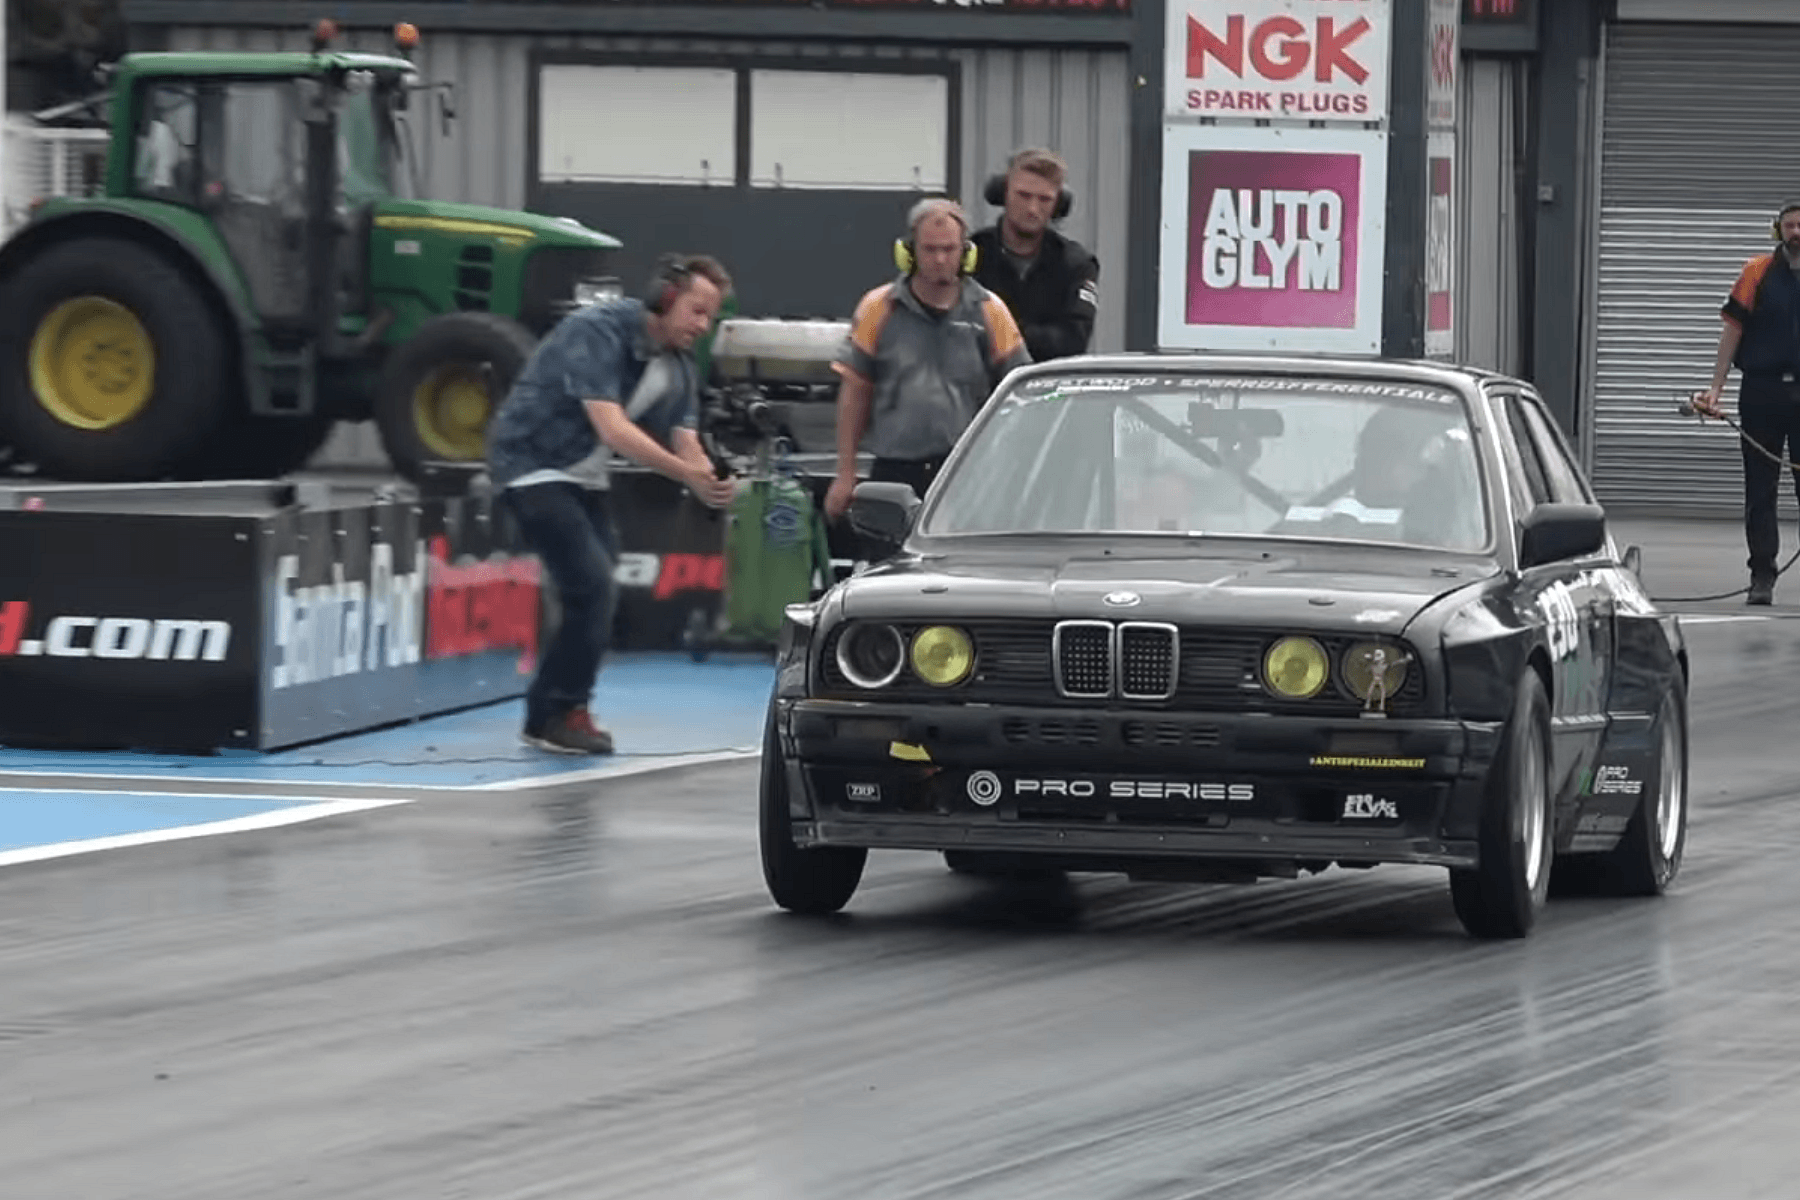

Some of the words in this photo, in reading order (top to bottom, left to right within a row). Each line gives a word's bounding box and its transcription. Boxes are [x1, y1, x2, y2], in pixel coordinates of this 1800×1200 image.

[1186, 13, 1371, 85] NGK
[1187, 89, 1271, 110] SPARK
[1280, 92, 1368, 113] PLUGS
[1203, 188, 1342, 240] AUTO
[1202, 237, 1341, 290] GLYM
[1014, 779, 1095, 796] PRO
[1110, 781, 1254, 800] SERIES
